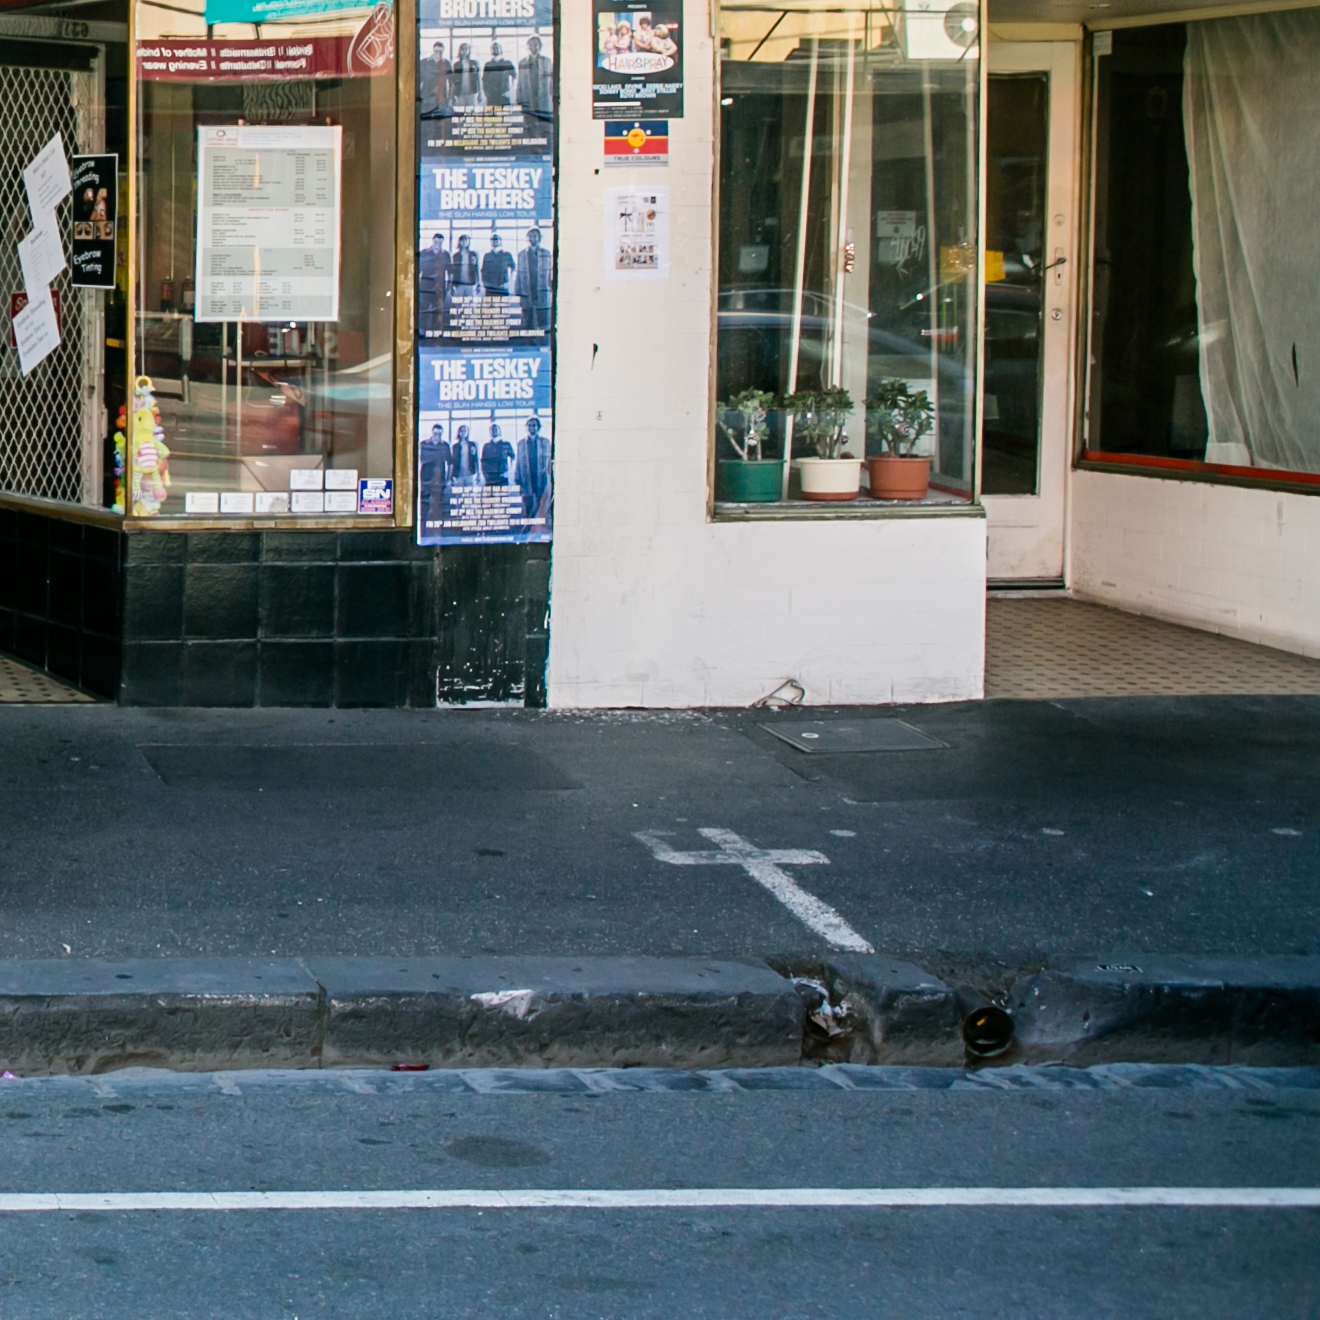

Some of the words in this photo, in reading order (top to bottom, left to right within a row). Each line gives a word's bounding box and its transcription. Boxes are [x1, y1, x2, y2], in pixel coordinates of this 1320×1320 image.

[608, 56, 668, 70] HAIRSPRAY
[432, 168, 468, 189] THE
[472, 168, 543, 189] TESKEY
[440, 189, 535, 210] BROTHERS
[73, 250, 102, 265] Eyebrow
[81, 262, 102, 274] Tinting
[431, 359, 467, 380] THE
[471, 358, 541, 379] TESKEY
[439, 379, 534, 401] BROTHERS
